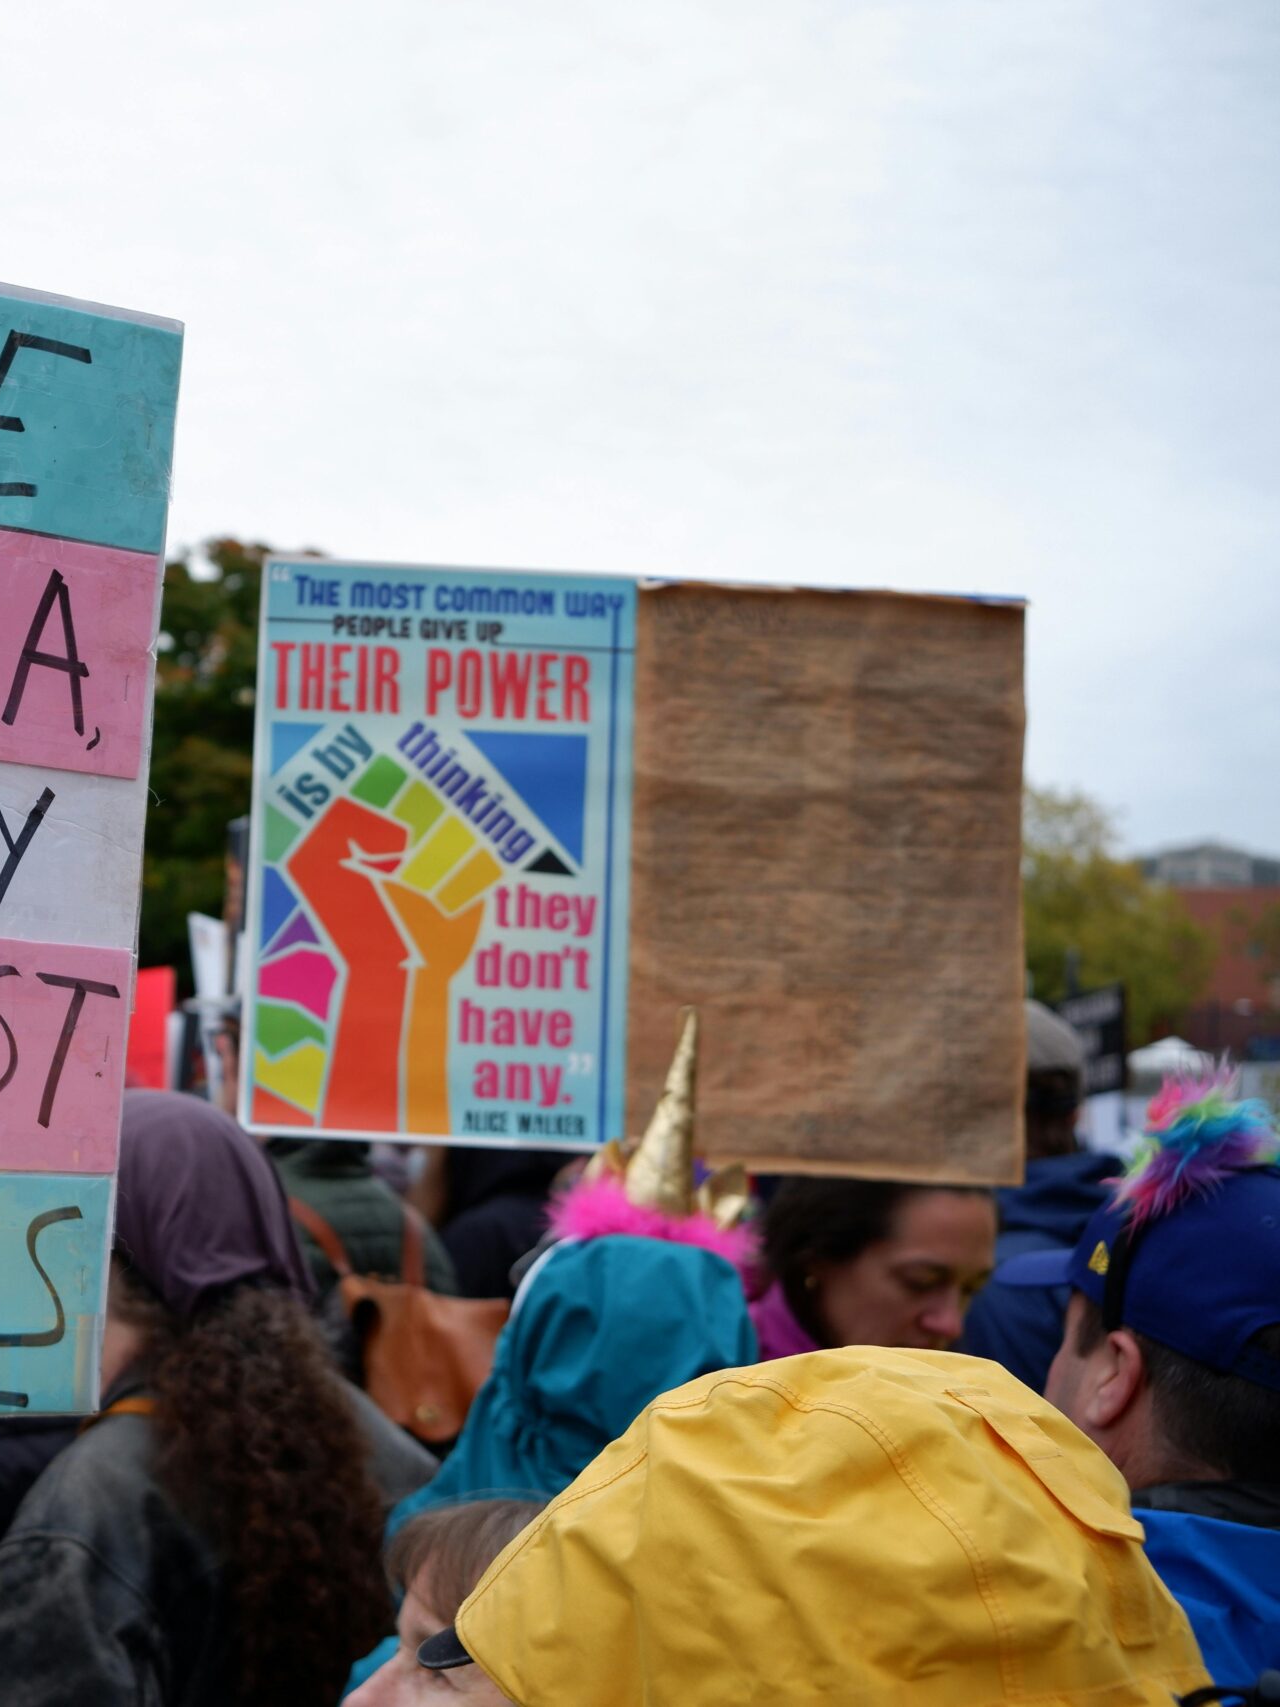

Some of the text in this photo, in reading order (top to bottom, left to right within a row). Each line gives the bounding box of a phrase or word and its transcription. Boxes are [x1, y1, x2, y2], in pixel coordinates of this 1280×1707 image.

[350, 580, 426, 611] MOST
[434, 586, 555, 616] COMMON
[564, 592, 626, 620] WAY
[333, 613, 505, 645] PEOPLE GIVE UP
[271, 642, 592, 724] THEIR POWER
[276, 723, 375, 820] is by
[395, 722, 537, 866] thinking
[494, 884, 599, 938] they
[476, 941, 592, 991] don’t
[458, 998, 575, 1049] have
[462, 1109, 588, 1138] ALICE WALKER
